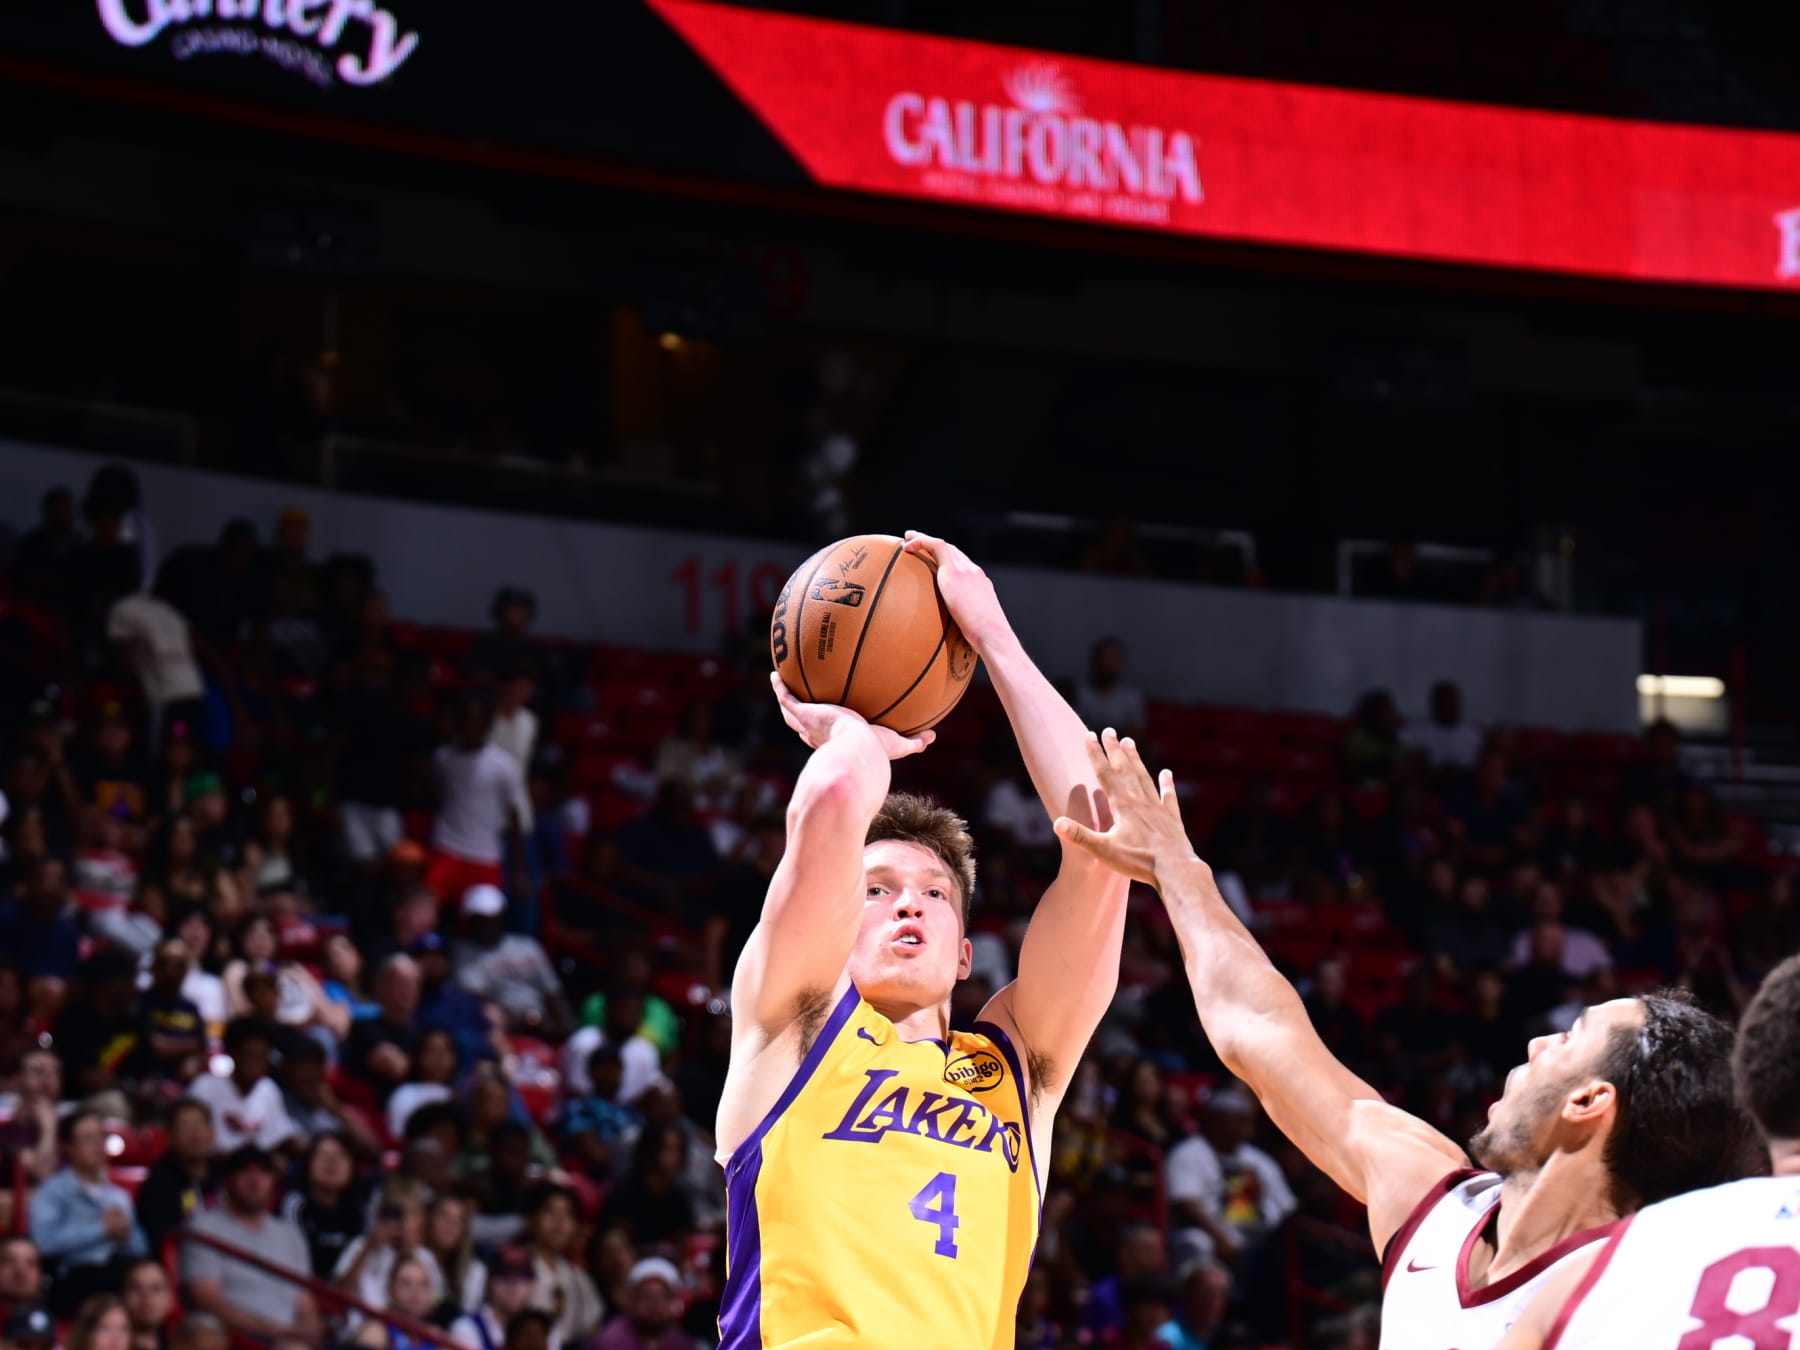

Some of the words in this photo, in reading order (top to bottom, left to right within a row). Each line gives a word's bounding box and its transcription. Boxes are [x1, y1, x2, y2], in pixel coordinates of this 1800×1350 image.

[884, 91, 1204, 206] CALIFORNIA
[948, 1062, 999, 1081] bibigo
[908, 1172, 959, 1259] 4
